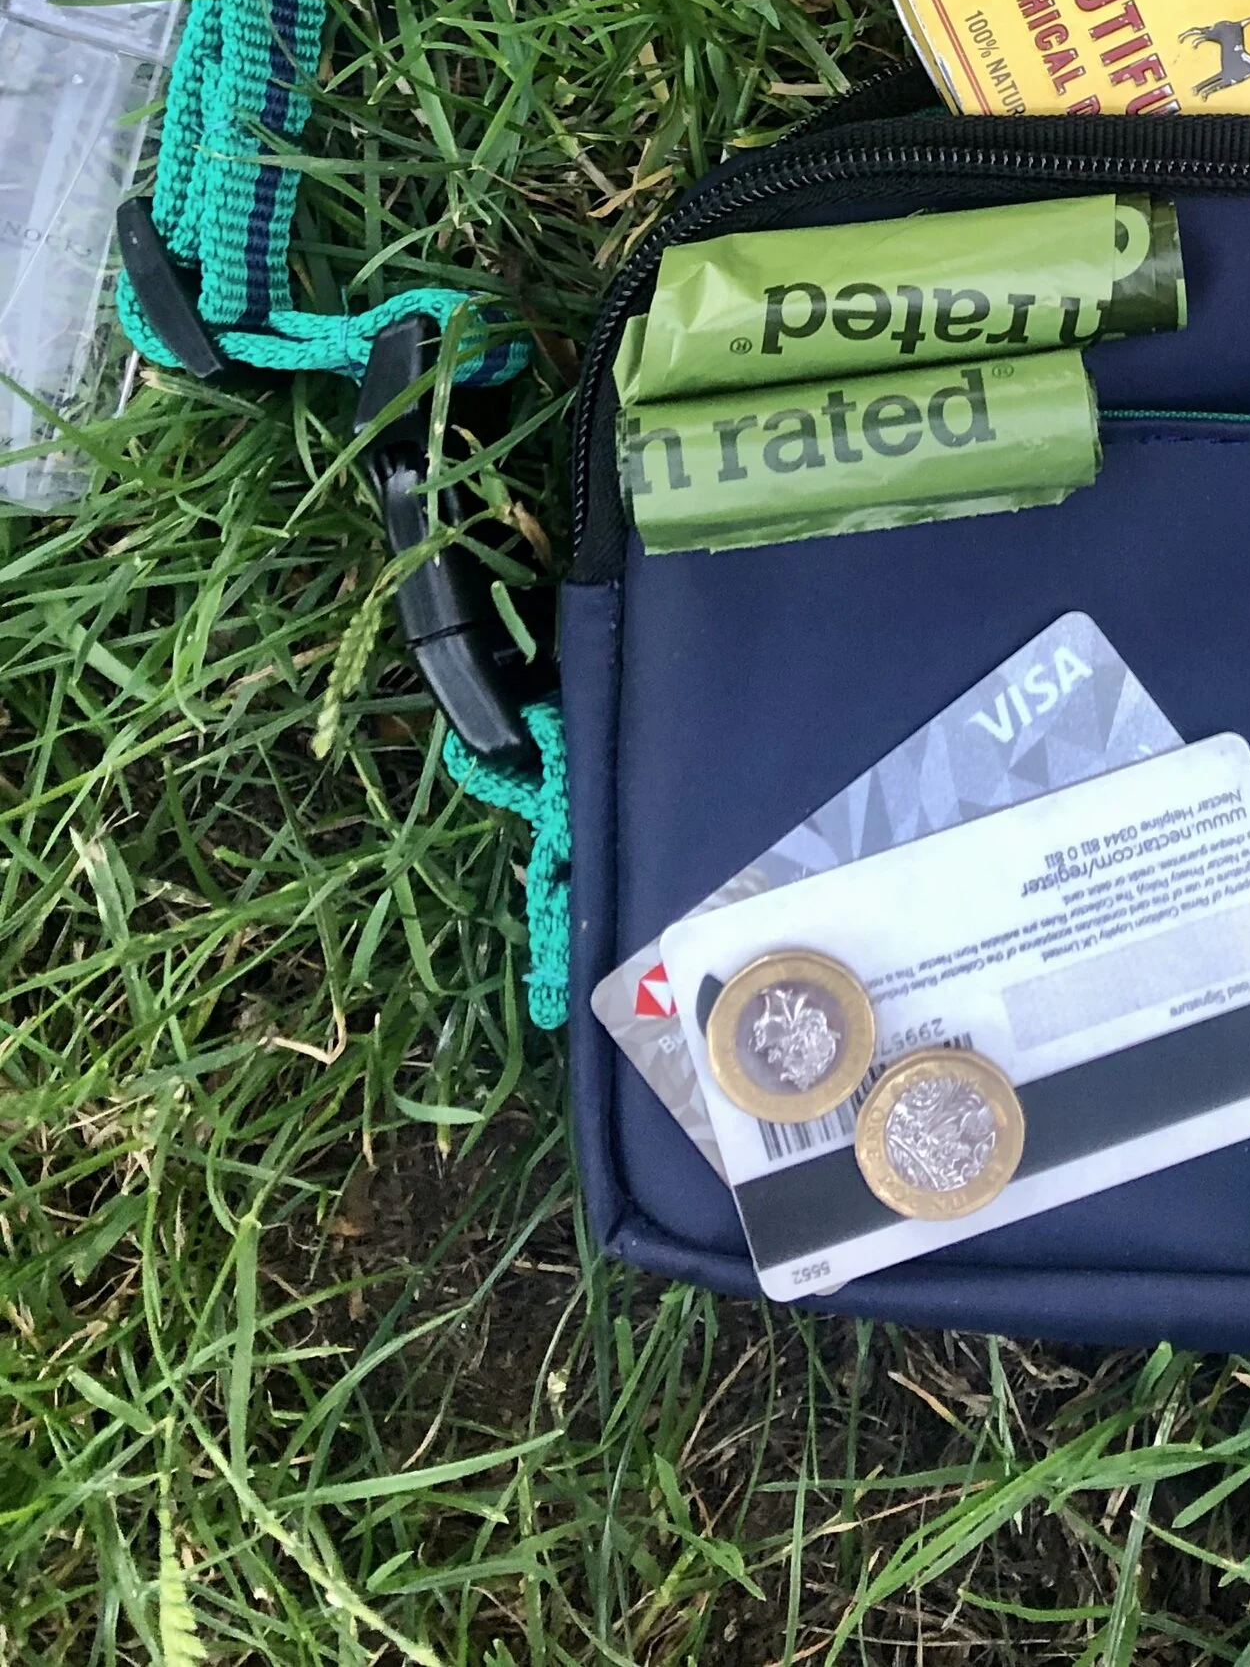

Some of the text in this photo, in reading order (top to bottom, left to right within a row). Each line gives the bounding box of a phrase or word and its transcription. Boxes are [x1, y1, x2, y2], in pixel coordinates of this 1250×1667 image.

[964, 9, 1000, 59] 100%
[968, 639, 1093, 743] VISA
[1197, 788, 1241, 814] Nectar
[1140, 806, 1195, 832] Helpline
[1103, 825, 1138, 848] 0344
[1020, 806, 1248, 898] www.nectar.com/register
[1169, 989, 1226, 1017] Signature
[791, 1260, 831, 1285] 5552
